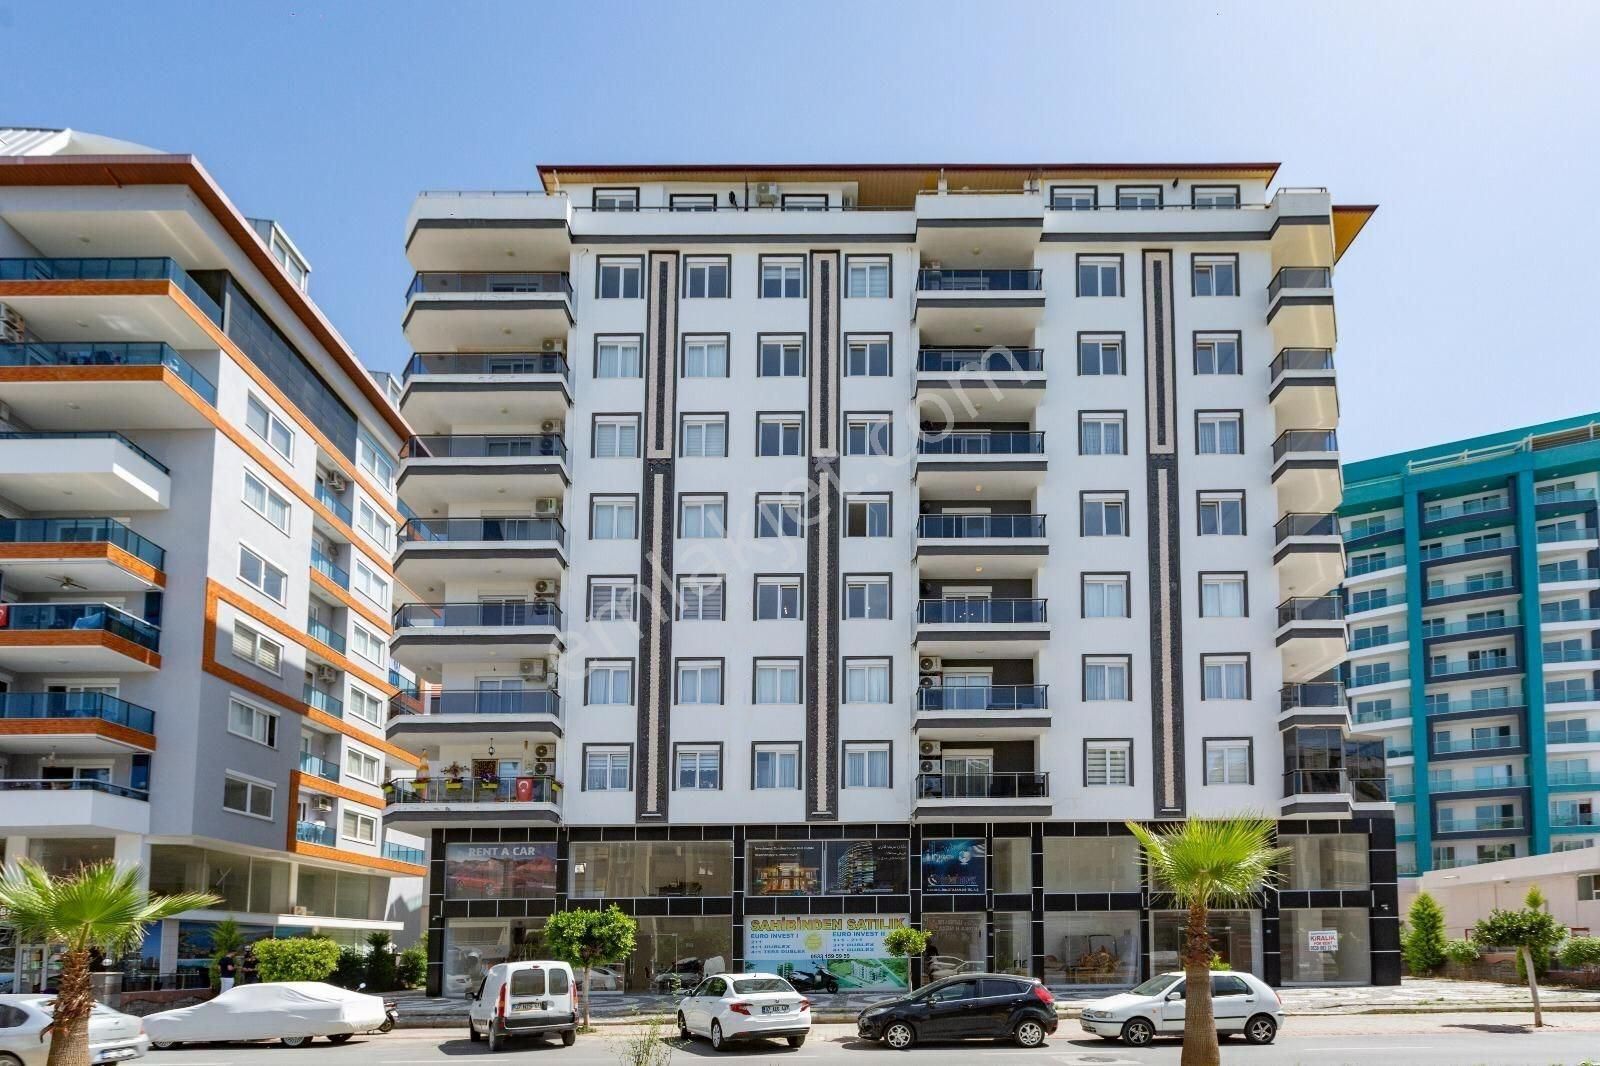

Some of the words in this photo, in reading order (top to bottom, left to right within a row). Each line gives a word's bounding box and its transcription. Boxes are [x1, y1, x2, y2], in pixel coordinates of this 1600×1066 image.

[469, 847, 498, 857] RENT
[501, 847, 510, 856] A
[513, 846, 535, 856] CAR
[750, 916, 842, 931] SAHİBİNDEN
[847, 917, 905, 931] SATILIK
